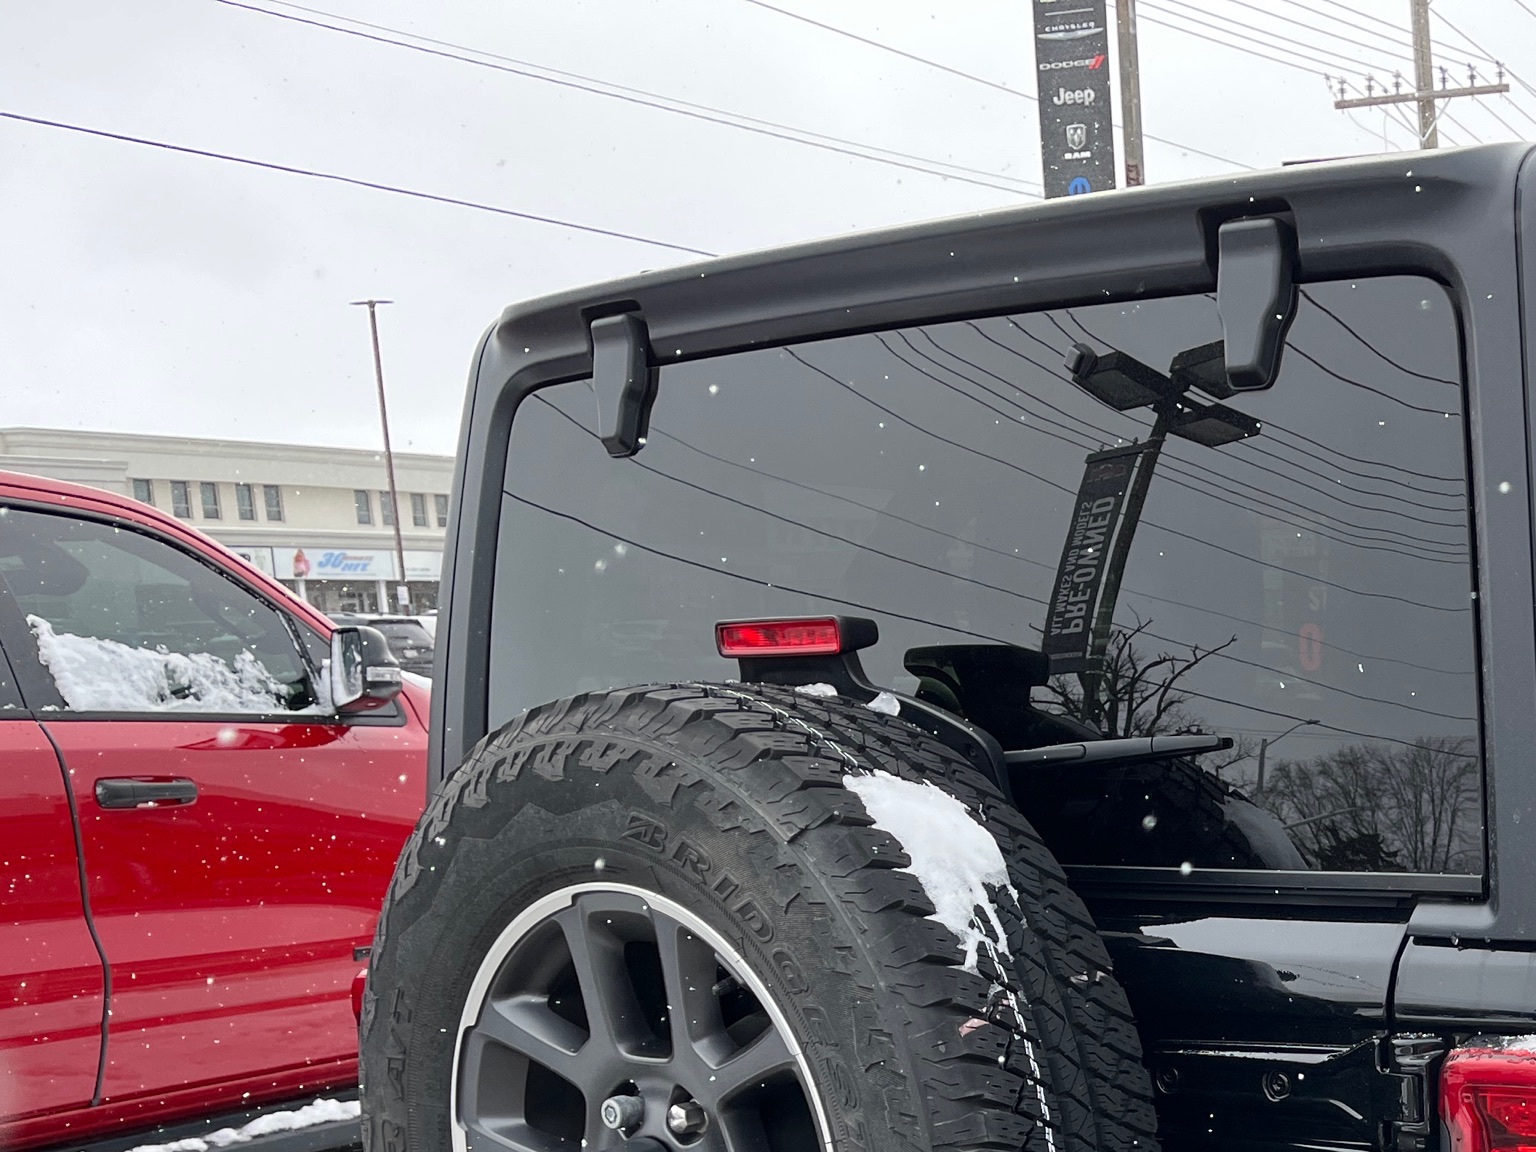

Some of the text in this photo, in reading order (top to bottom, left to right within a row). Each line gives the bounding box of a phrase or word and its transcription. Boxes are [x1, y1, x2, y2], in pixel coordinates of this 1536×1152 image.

[1045, 21, 1095, 32] CHRYSLER
[1039, 58, 1095, 70] DODGE
[1053, 87, 1095, 105] Jeep
[1064, 151, 1091, 160] RAM
